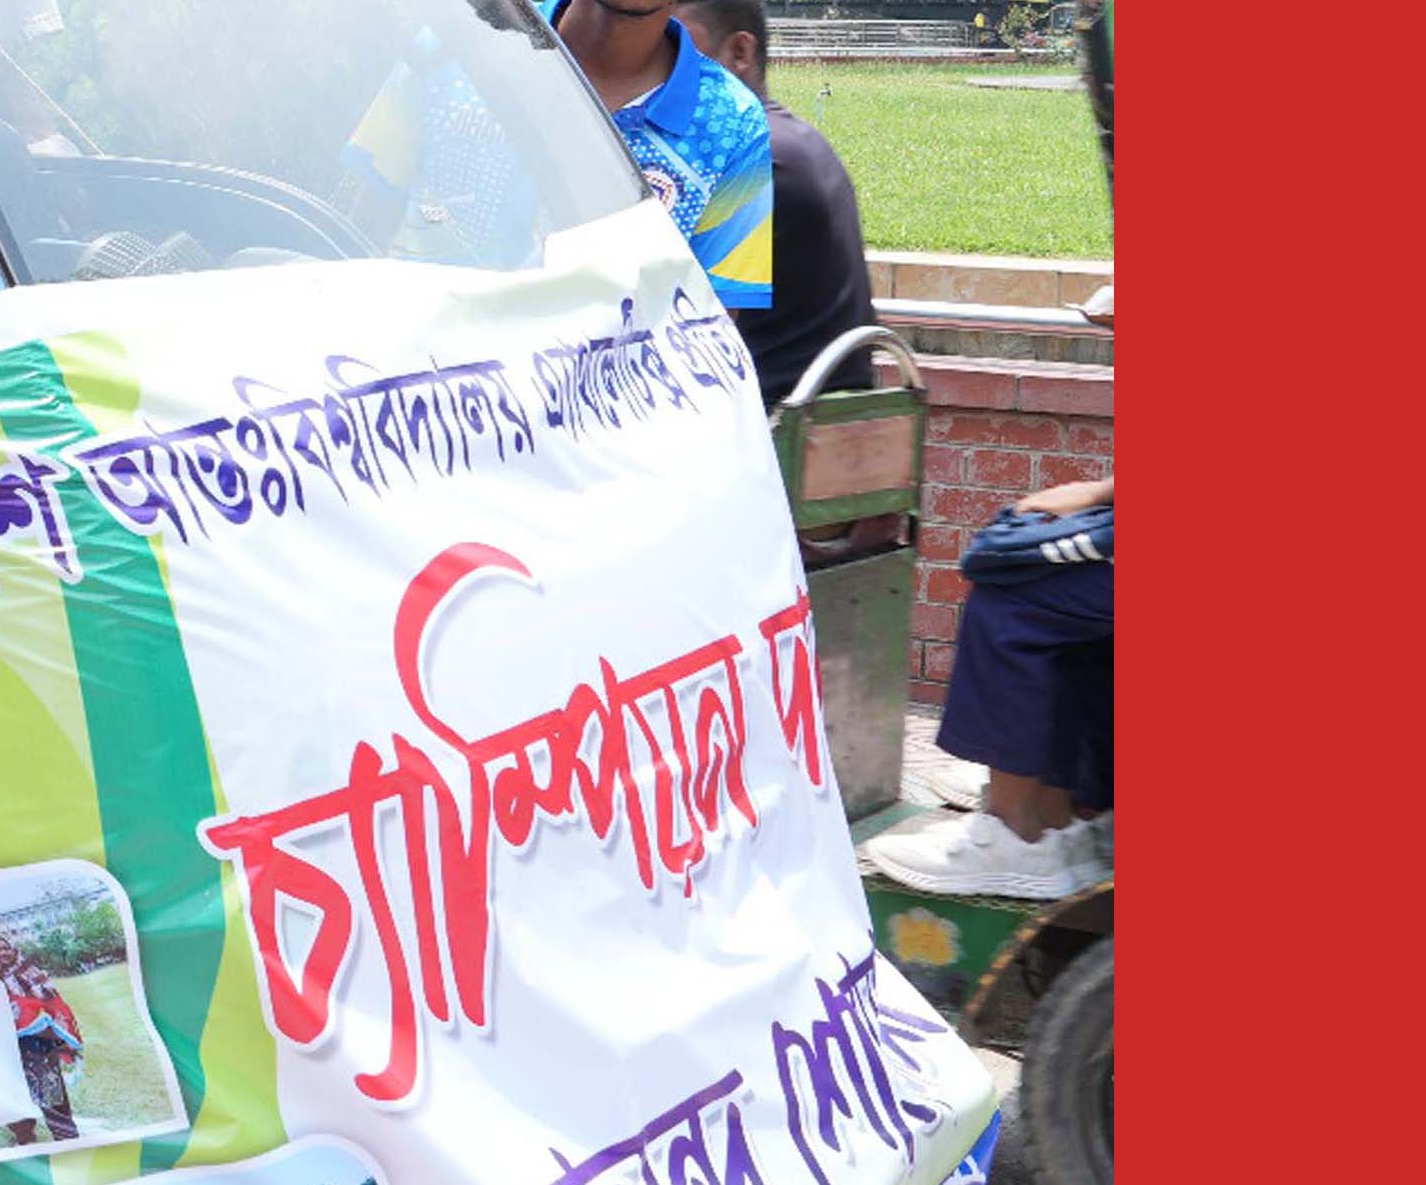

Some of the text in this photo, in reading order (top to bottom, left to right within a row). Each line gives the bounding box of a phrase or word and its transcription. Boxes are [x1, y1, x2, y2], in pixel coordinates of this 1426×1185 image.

[665, 286, 752, 398] প্রতি
[205, 541, 823, 1102] চ্যাম্পিয়ন দ
